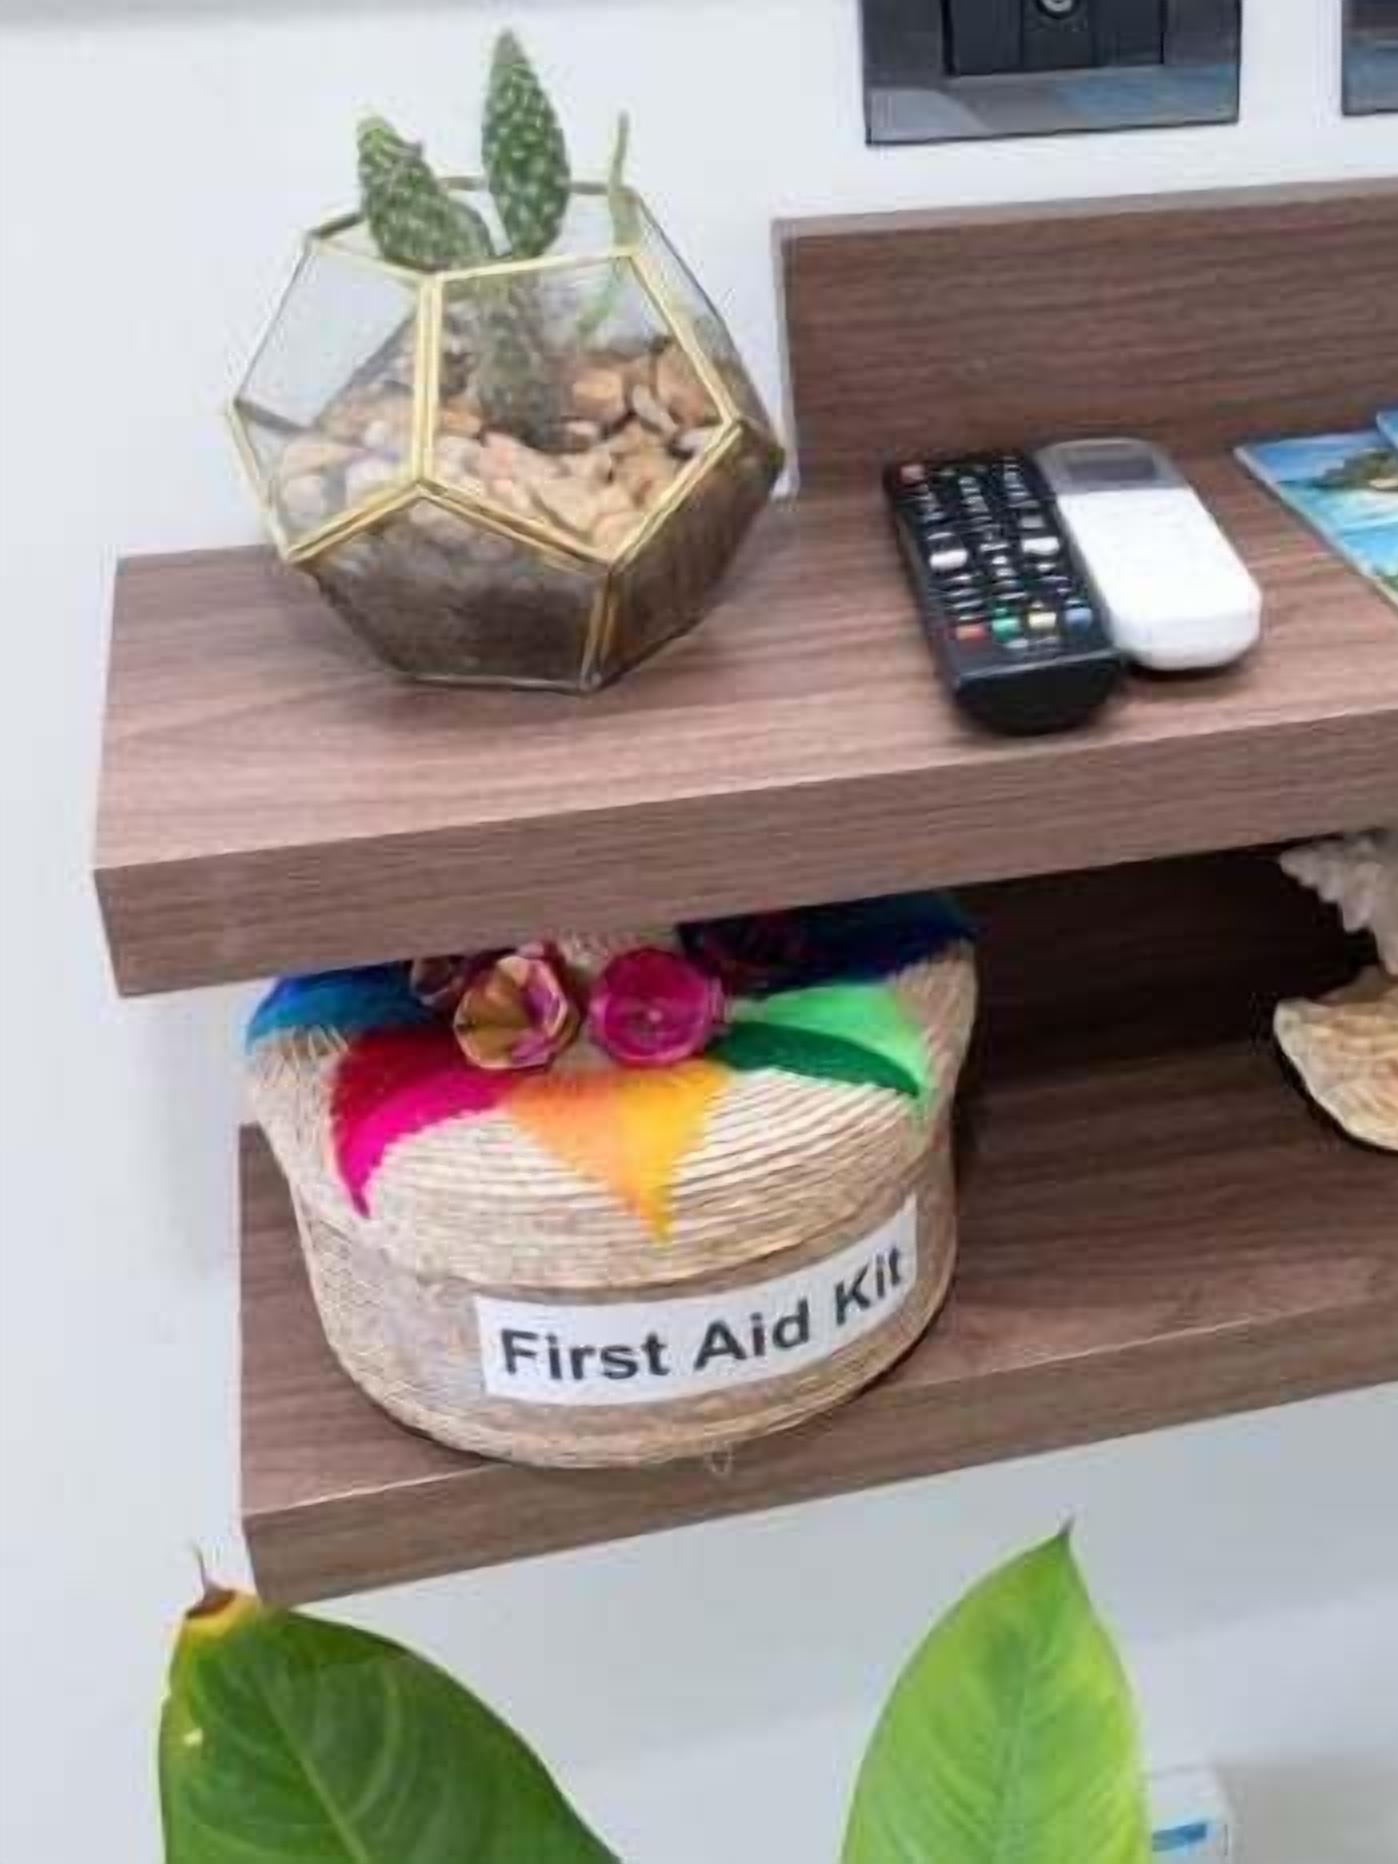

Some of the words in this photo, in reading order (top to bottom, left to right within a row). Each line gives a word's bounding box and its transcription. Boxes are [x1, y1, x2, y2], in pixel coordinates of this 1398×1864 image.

[499, 1327, 670, 1381] First
[692, 1297, 810, 1371] Aid
[834, 1245, 904, 1326] Kit
